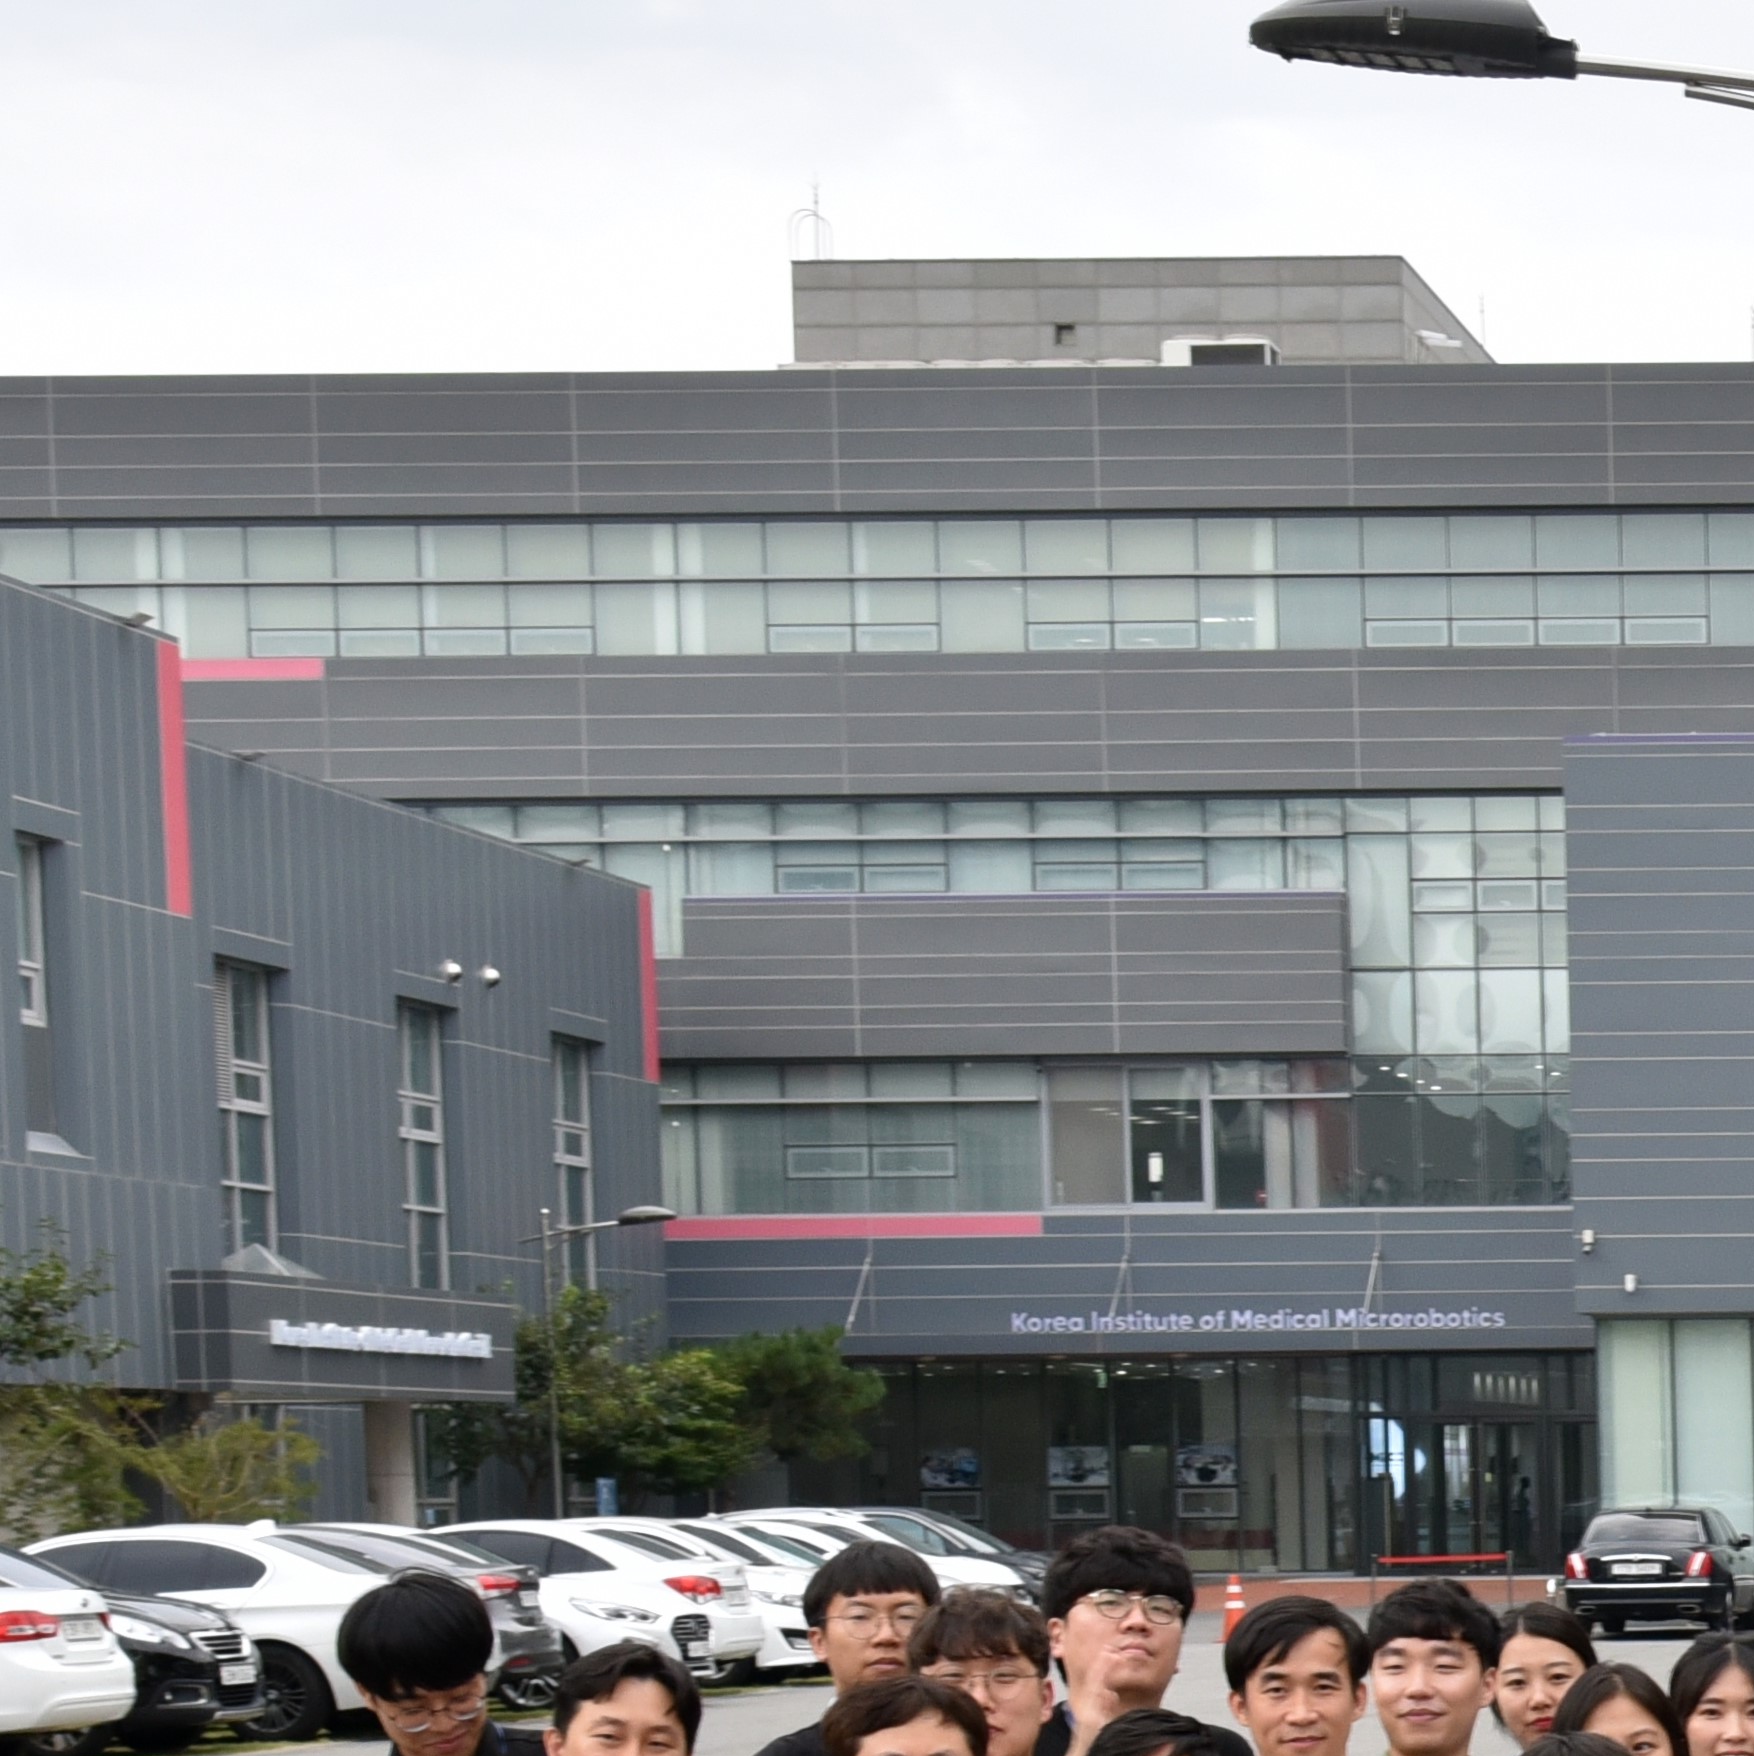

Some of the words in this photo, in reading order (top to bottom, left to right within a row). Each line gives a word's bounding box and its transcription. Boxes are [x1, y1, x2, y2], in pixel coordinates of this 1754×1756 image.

[1010, 1312, 1085, 1333] Korea
[1091, 1310, 1195, 1332] Institute
[1199, 1309, 1226, 1331] of
[1230, 1308, 1330, 1330] Medical
[1335, 1306, 1507, 1329] Microrobotics
